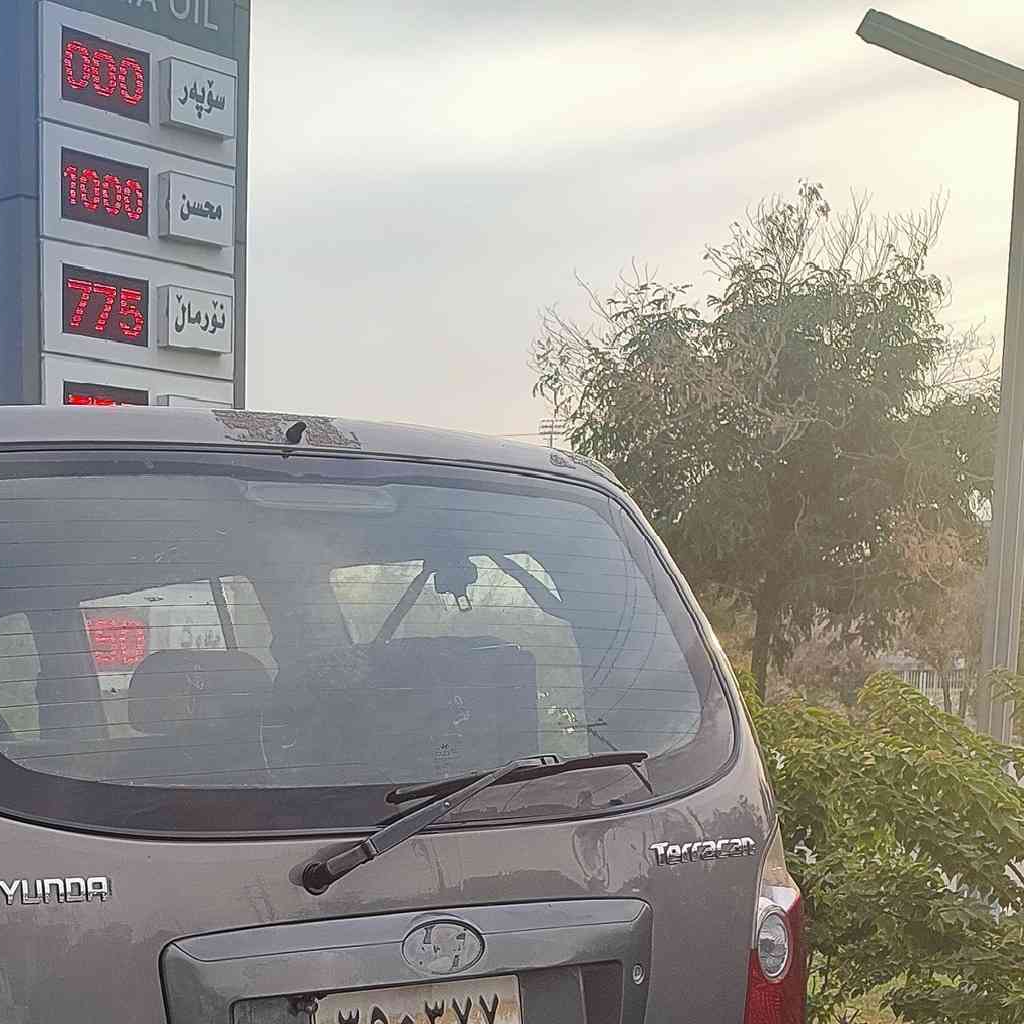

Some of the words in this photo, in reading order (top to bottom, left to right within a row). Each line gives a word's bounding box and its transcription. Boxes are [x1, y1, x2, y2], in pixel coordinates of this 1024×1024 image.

[63, 40, 145, 105] 000
[63, 165, 144, 221] 1000
[179, 193, 223, 221] محسن
[67, 278, 144, 337] 775
[650, 835, 757, 866] Terracan
